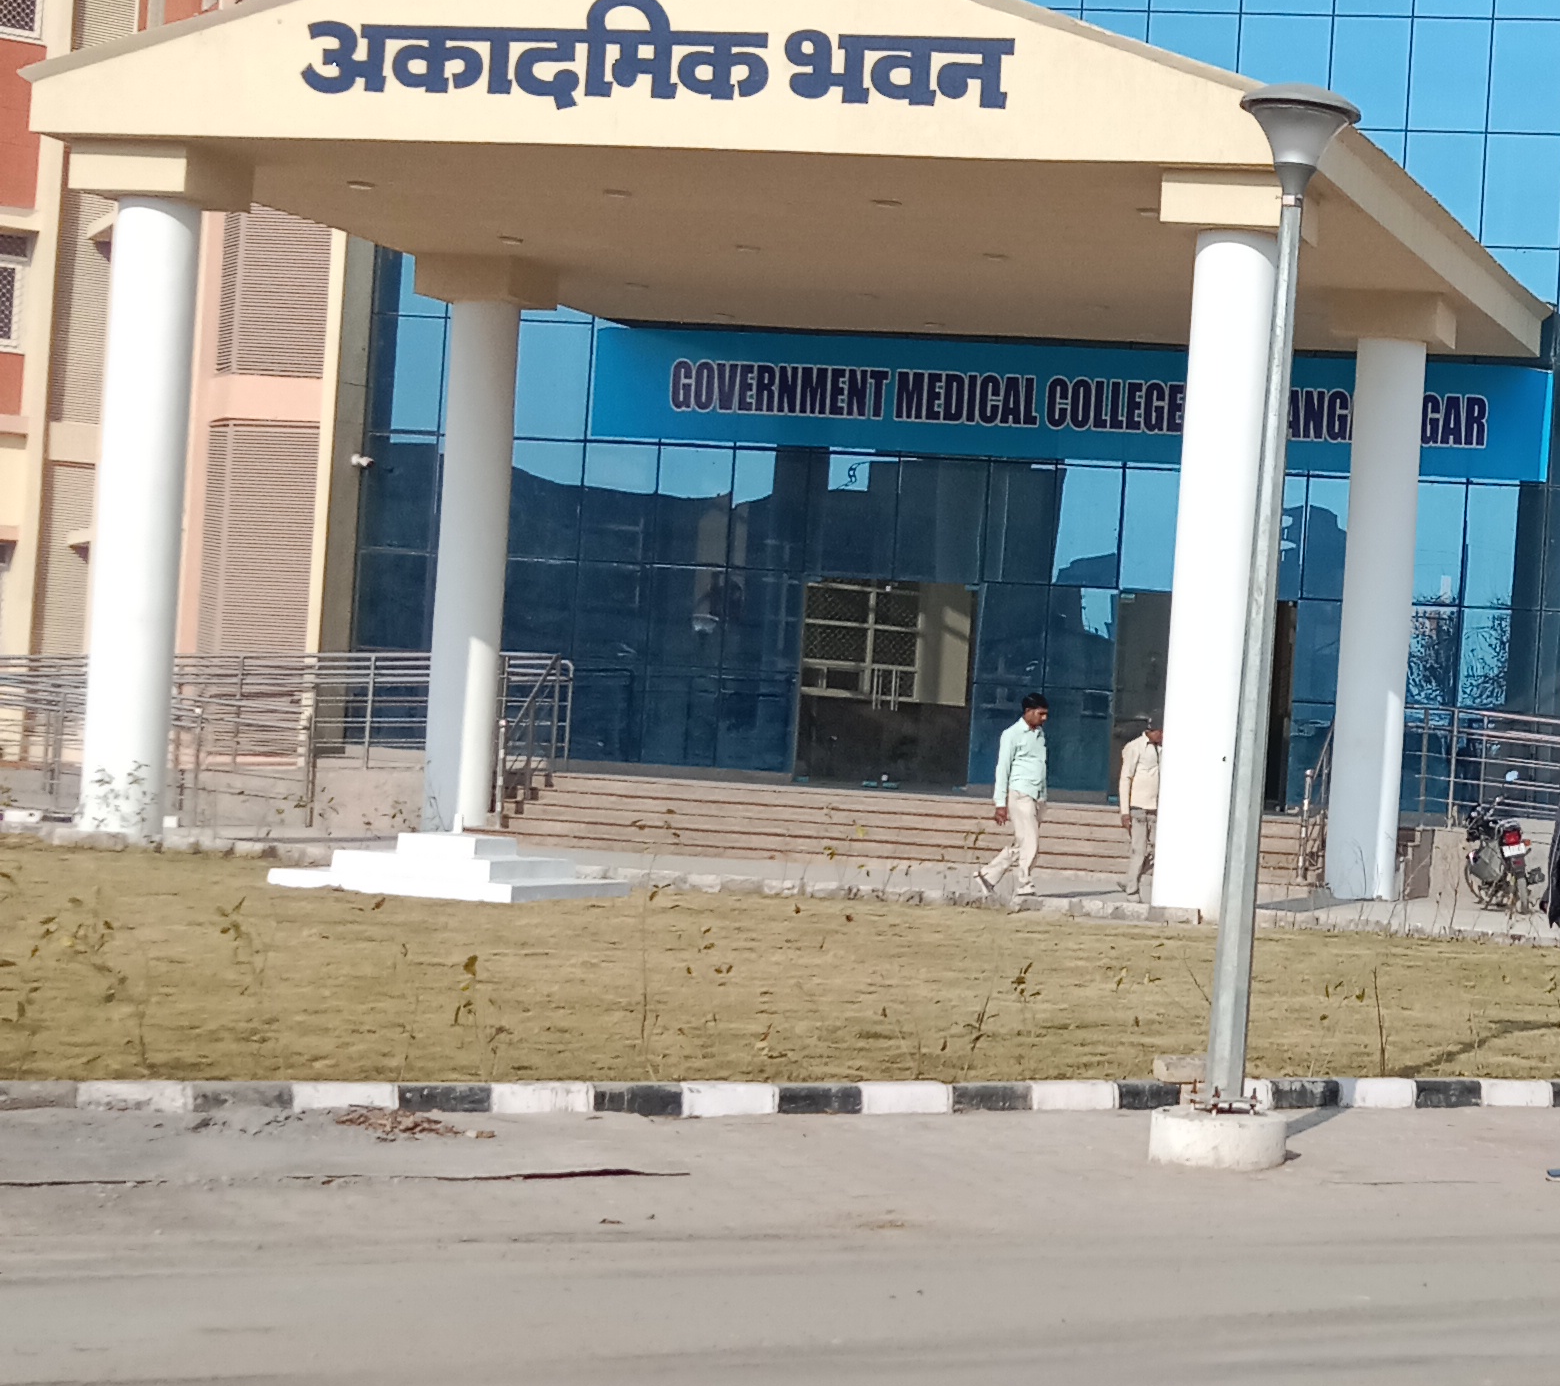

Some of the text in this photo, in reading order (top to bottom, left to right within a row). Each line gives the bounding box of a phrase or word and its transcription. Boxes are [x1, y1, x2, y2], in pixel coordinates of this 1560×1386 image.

[784, 29, 1016, 109] भवन
[670, 358, 891, 421] GOVERNMENT
[893, 368, 1040, 428] MEDICAL
[1045, 375, 1185, 435] COLLEGE
